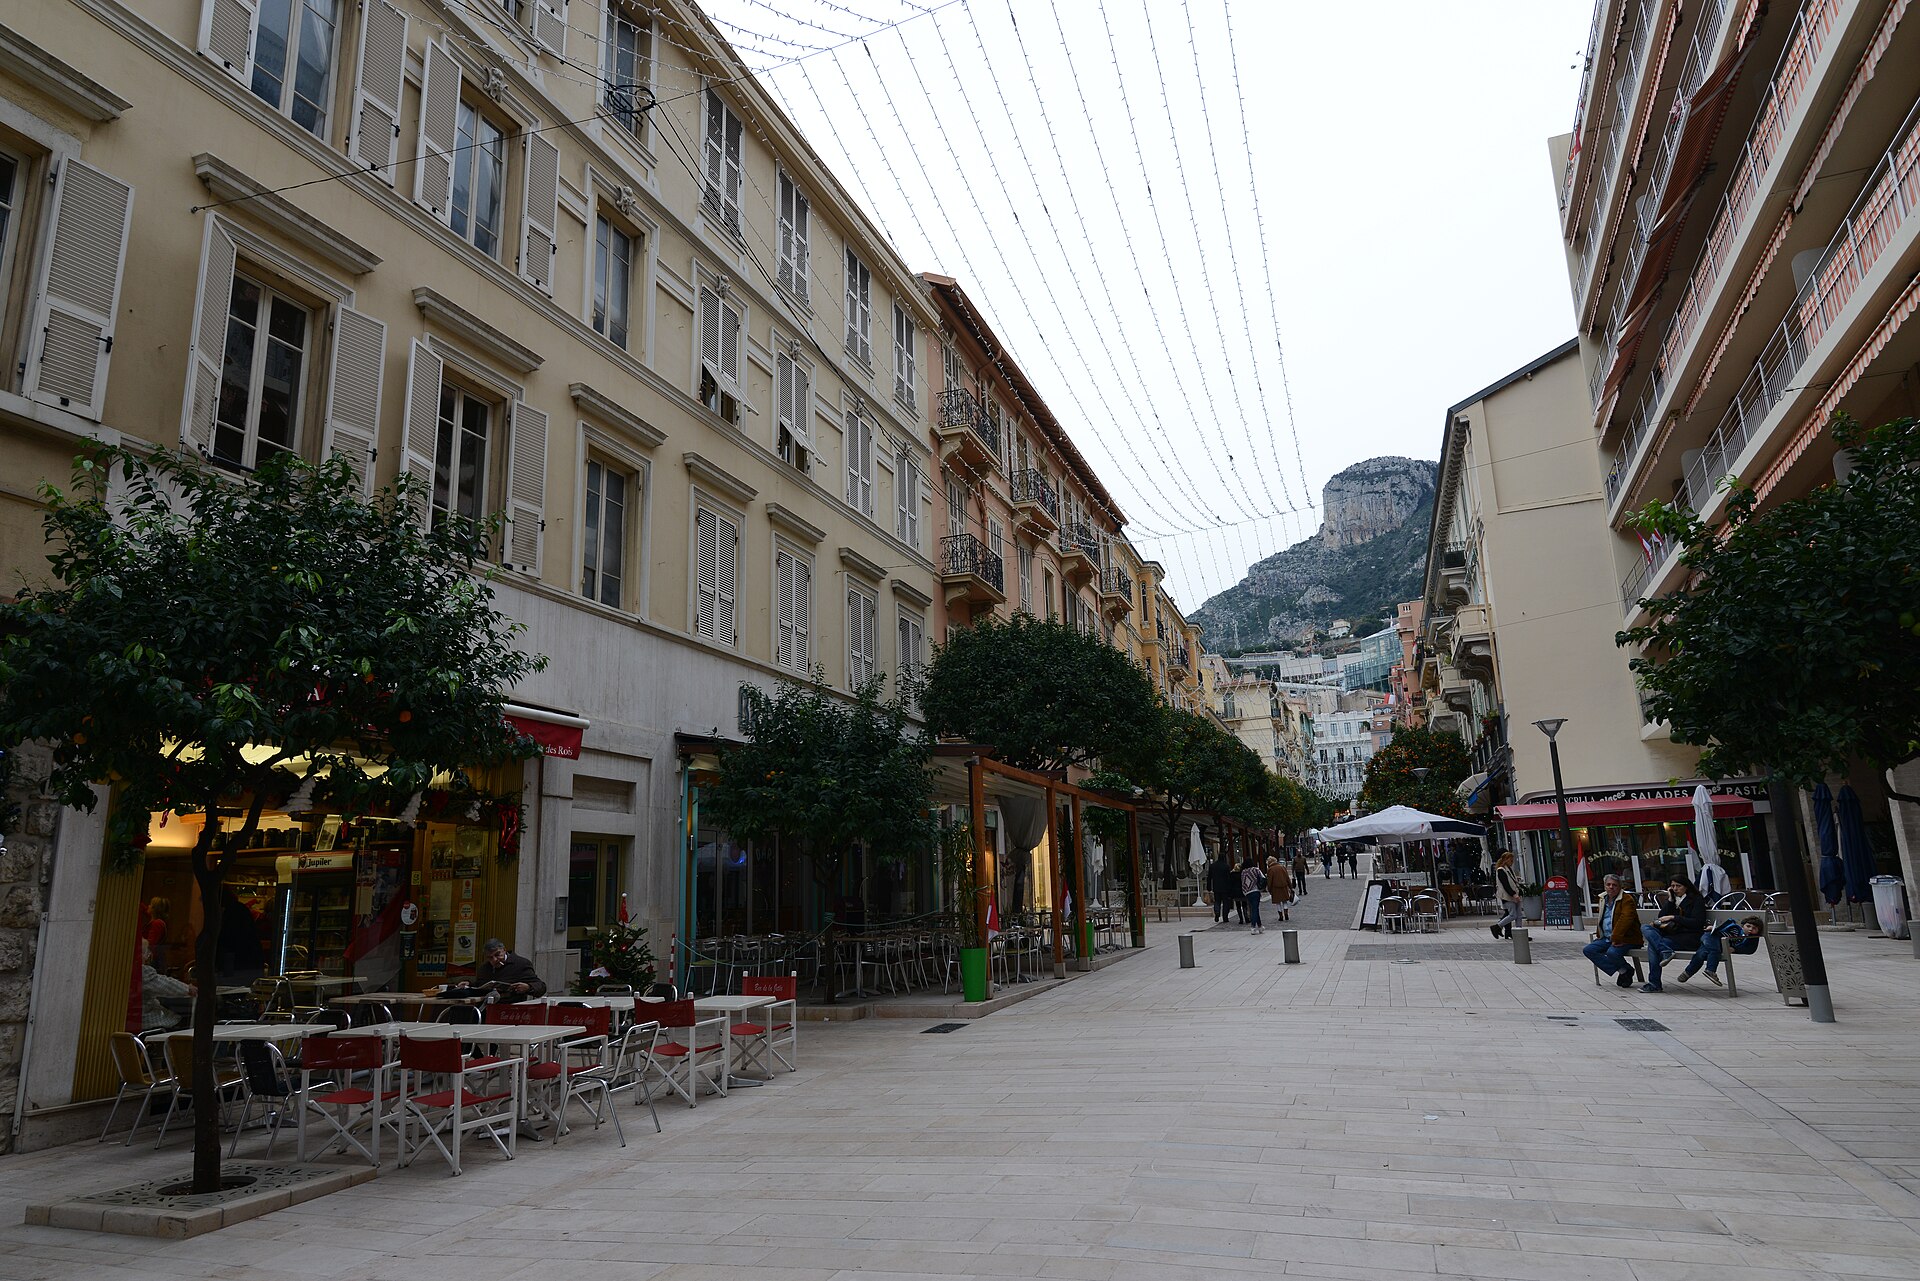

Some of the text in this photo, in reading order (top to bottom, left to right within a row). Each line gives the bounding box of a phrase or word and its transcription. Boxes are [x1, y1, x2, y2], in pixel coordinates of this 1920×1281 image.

[545, 743, 573, 756] des Rois
[1630, 788, 1689, 801] SALADES
[1726, 785, 1768, 797] PASTA
[307, 858, 332, 868] Jupiler
[1587, 850, 1631, 864] SALADES
[418, 953, 447, 965] JUDO
